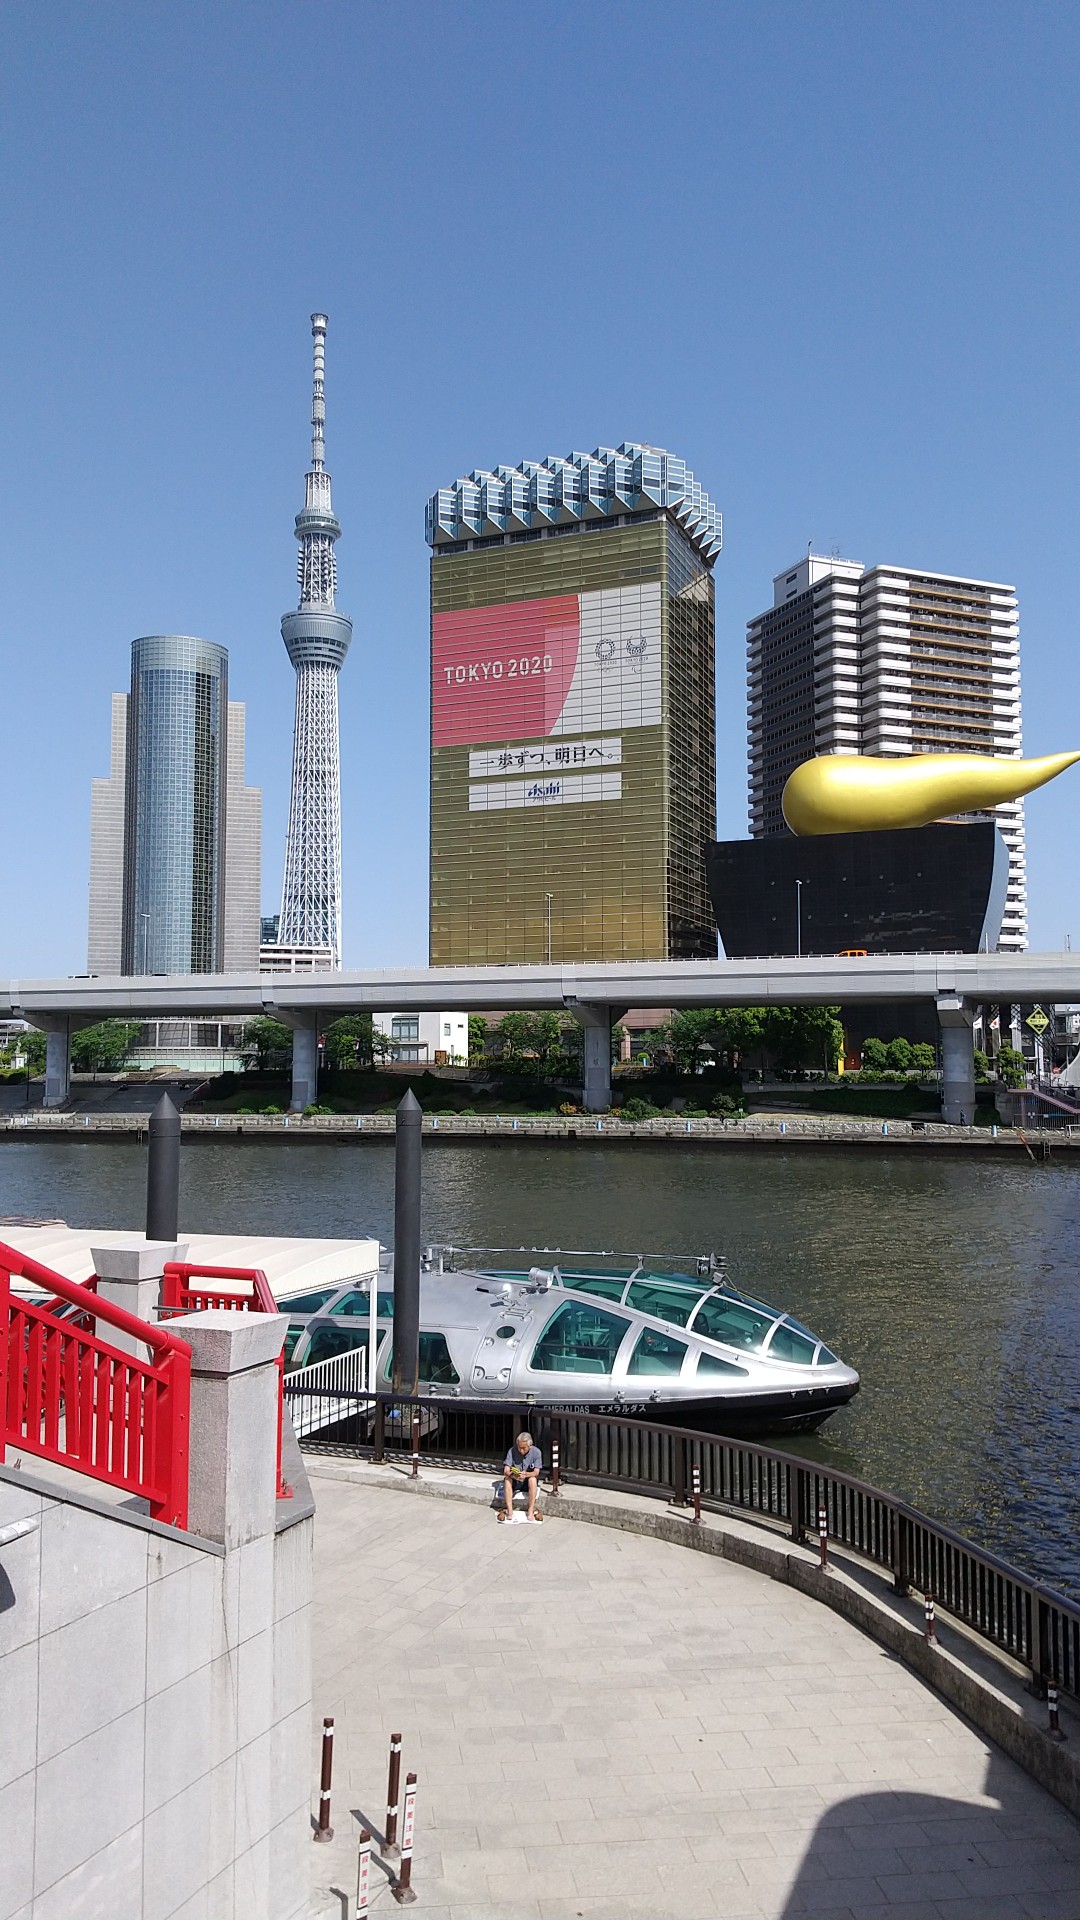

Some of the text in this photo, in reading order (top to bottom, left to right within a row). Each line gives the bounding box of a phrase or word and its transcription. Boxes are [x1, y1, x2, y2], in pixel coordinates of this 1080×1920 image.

[443, 654, 553, 685] TOKYO 2020
[480, 746, 613, 770] 一歩ずつ、明日へ。
[527, 781, 560, 797] Asahi
[598, 1404, 647, 1413] エメラルダス
